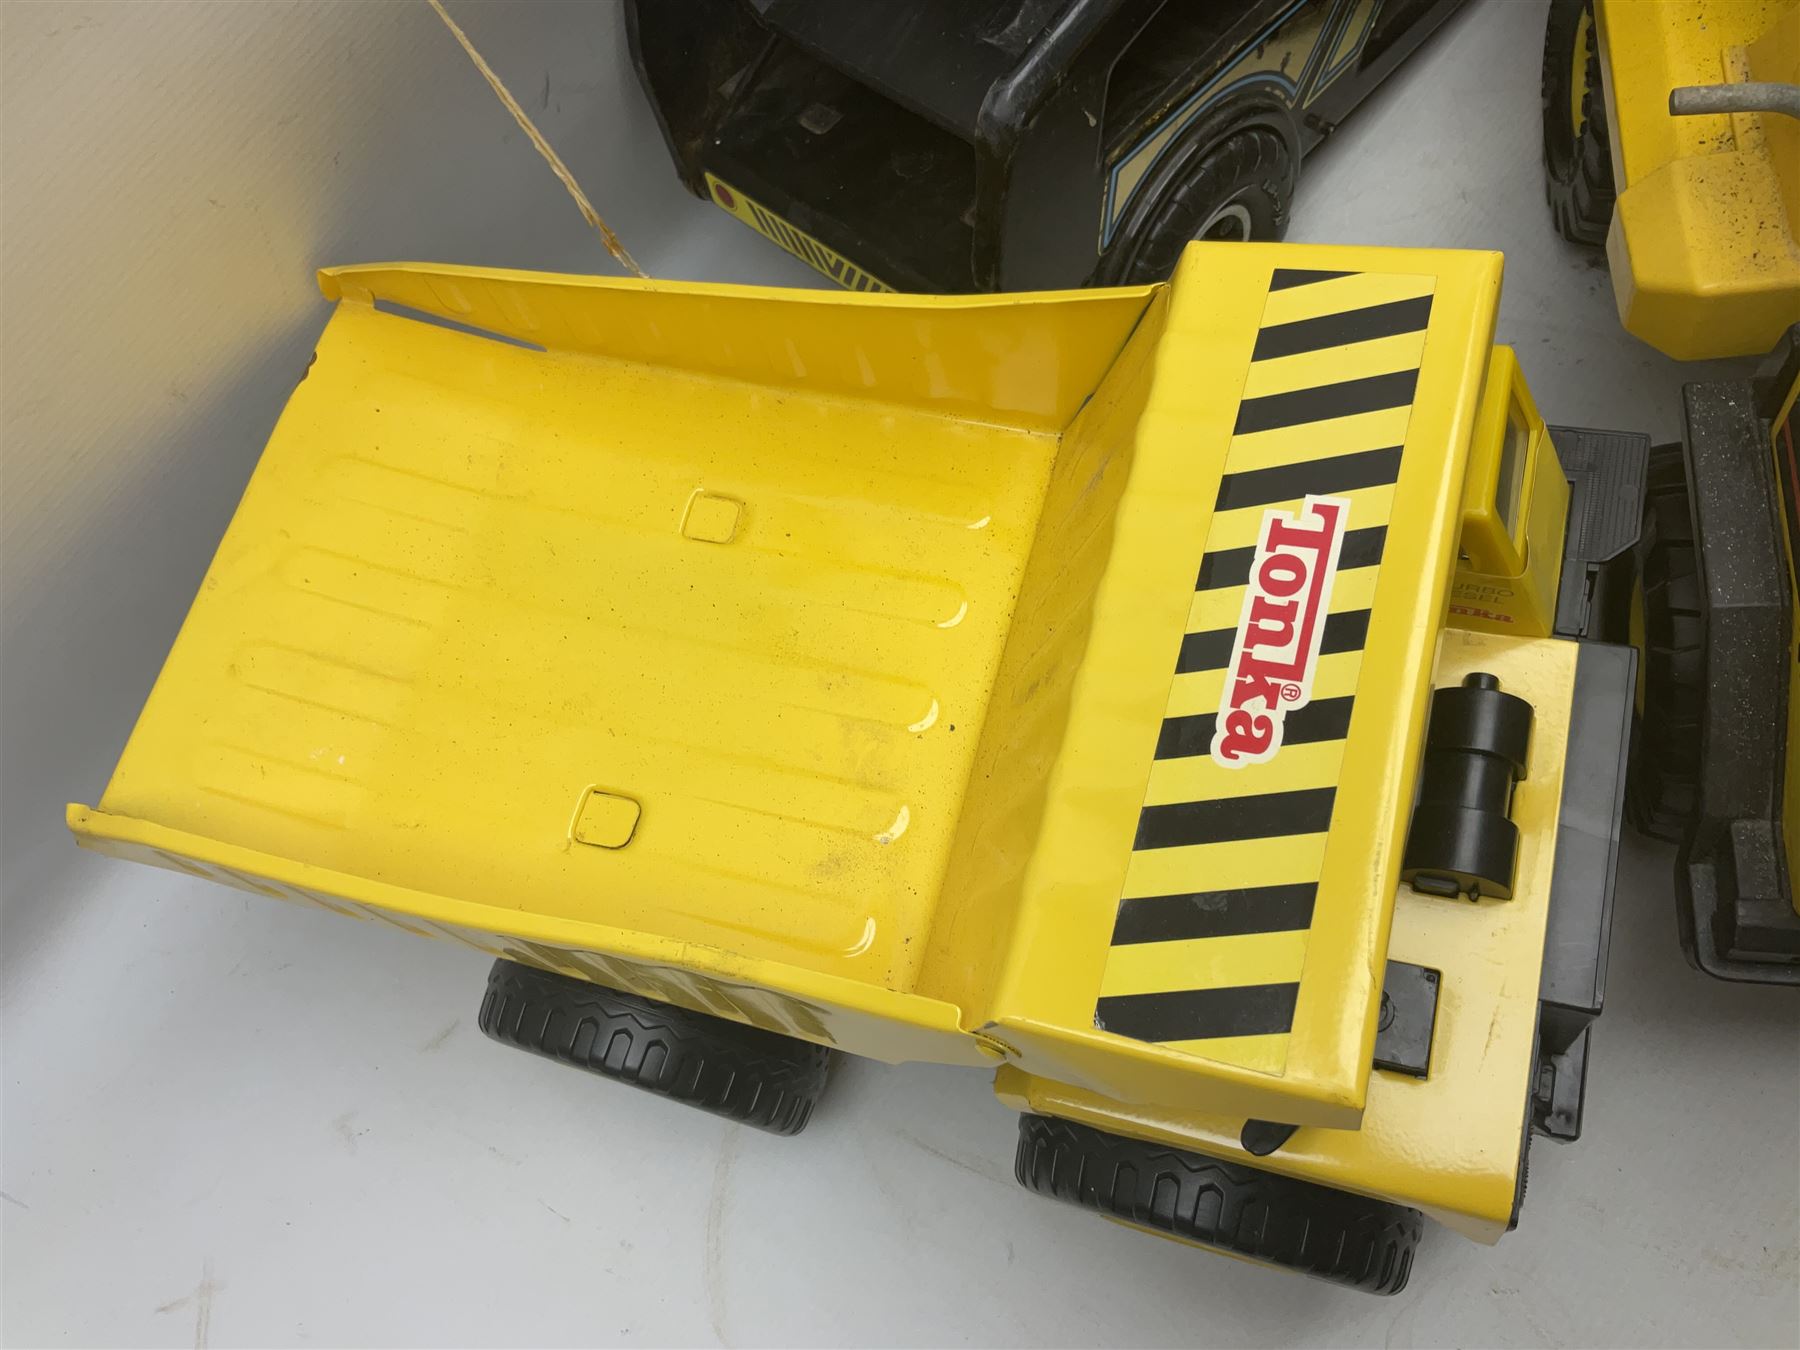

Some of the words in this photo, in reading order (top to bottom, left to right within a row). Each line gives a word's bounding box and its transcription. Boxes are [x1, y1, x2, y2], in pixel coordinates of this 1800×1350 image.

[1452, 590, 1504, 604] ESEL
[1453, 583, 1514, 597] URBO
[1449, 605, 1515, 623] nka
[1220, 503, 1340, 760] Tonka
